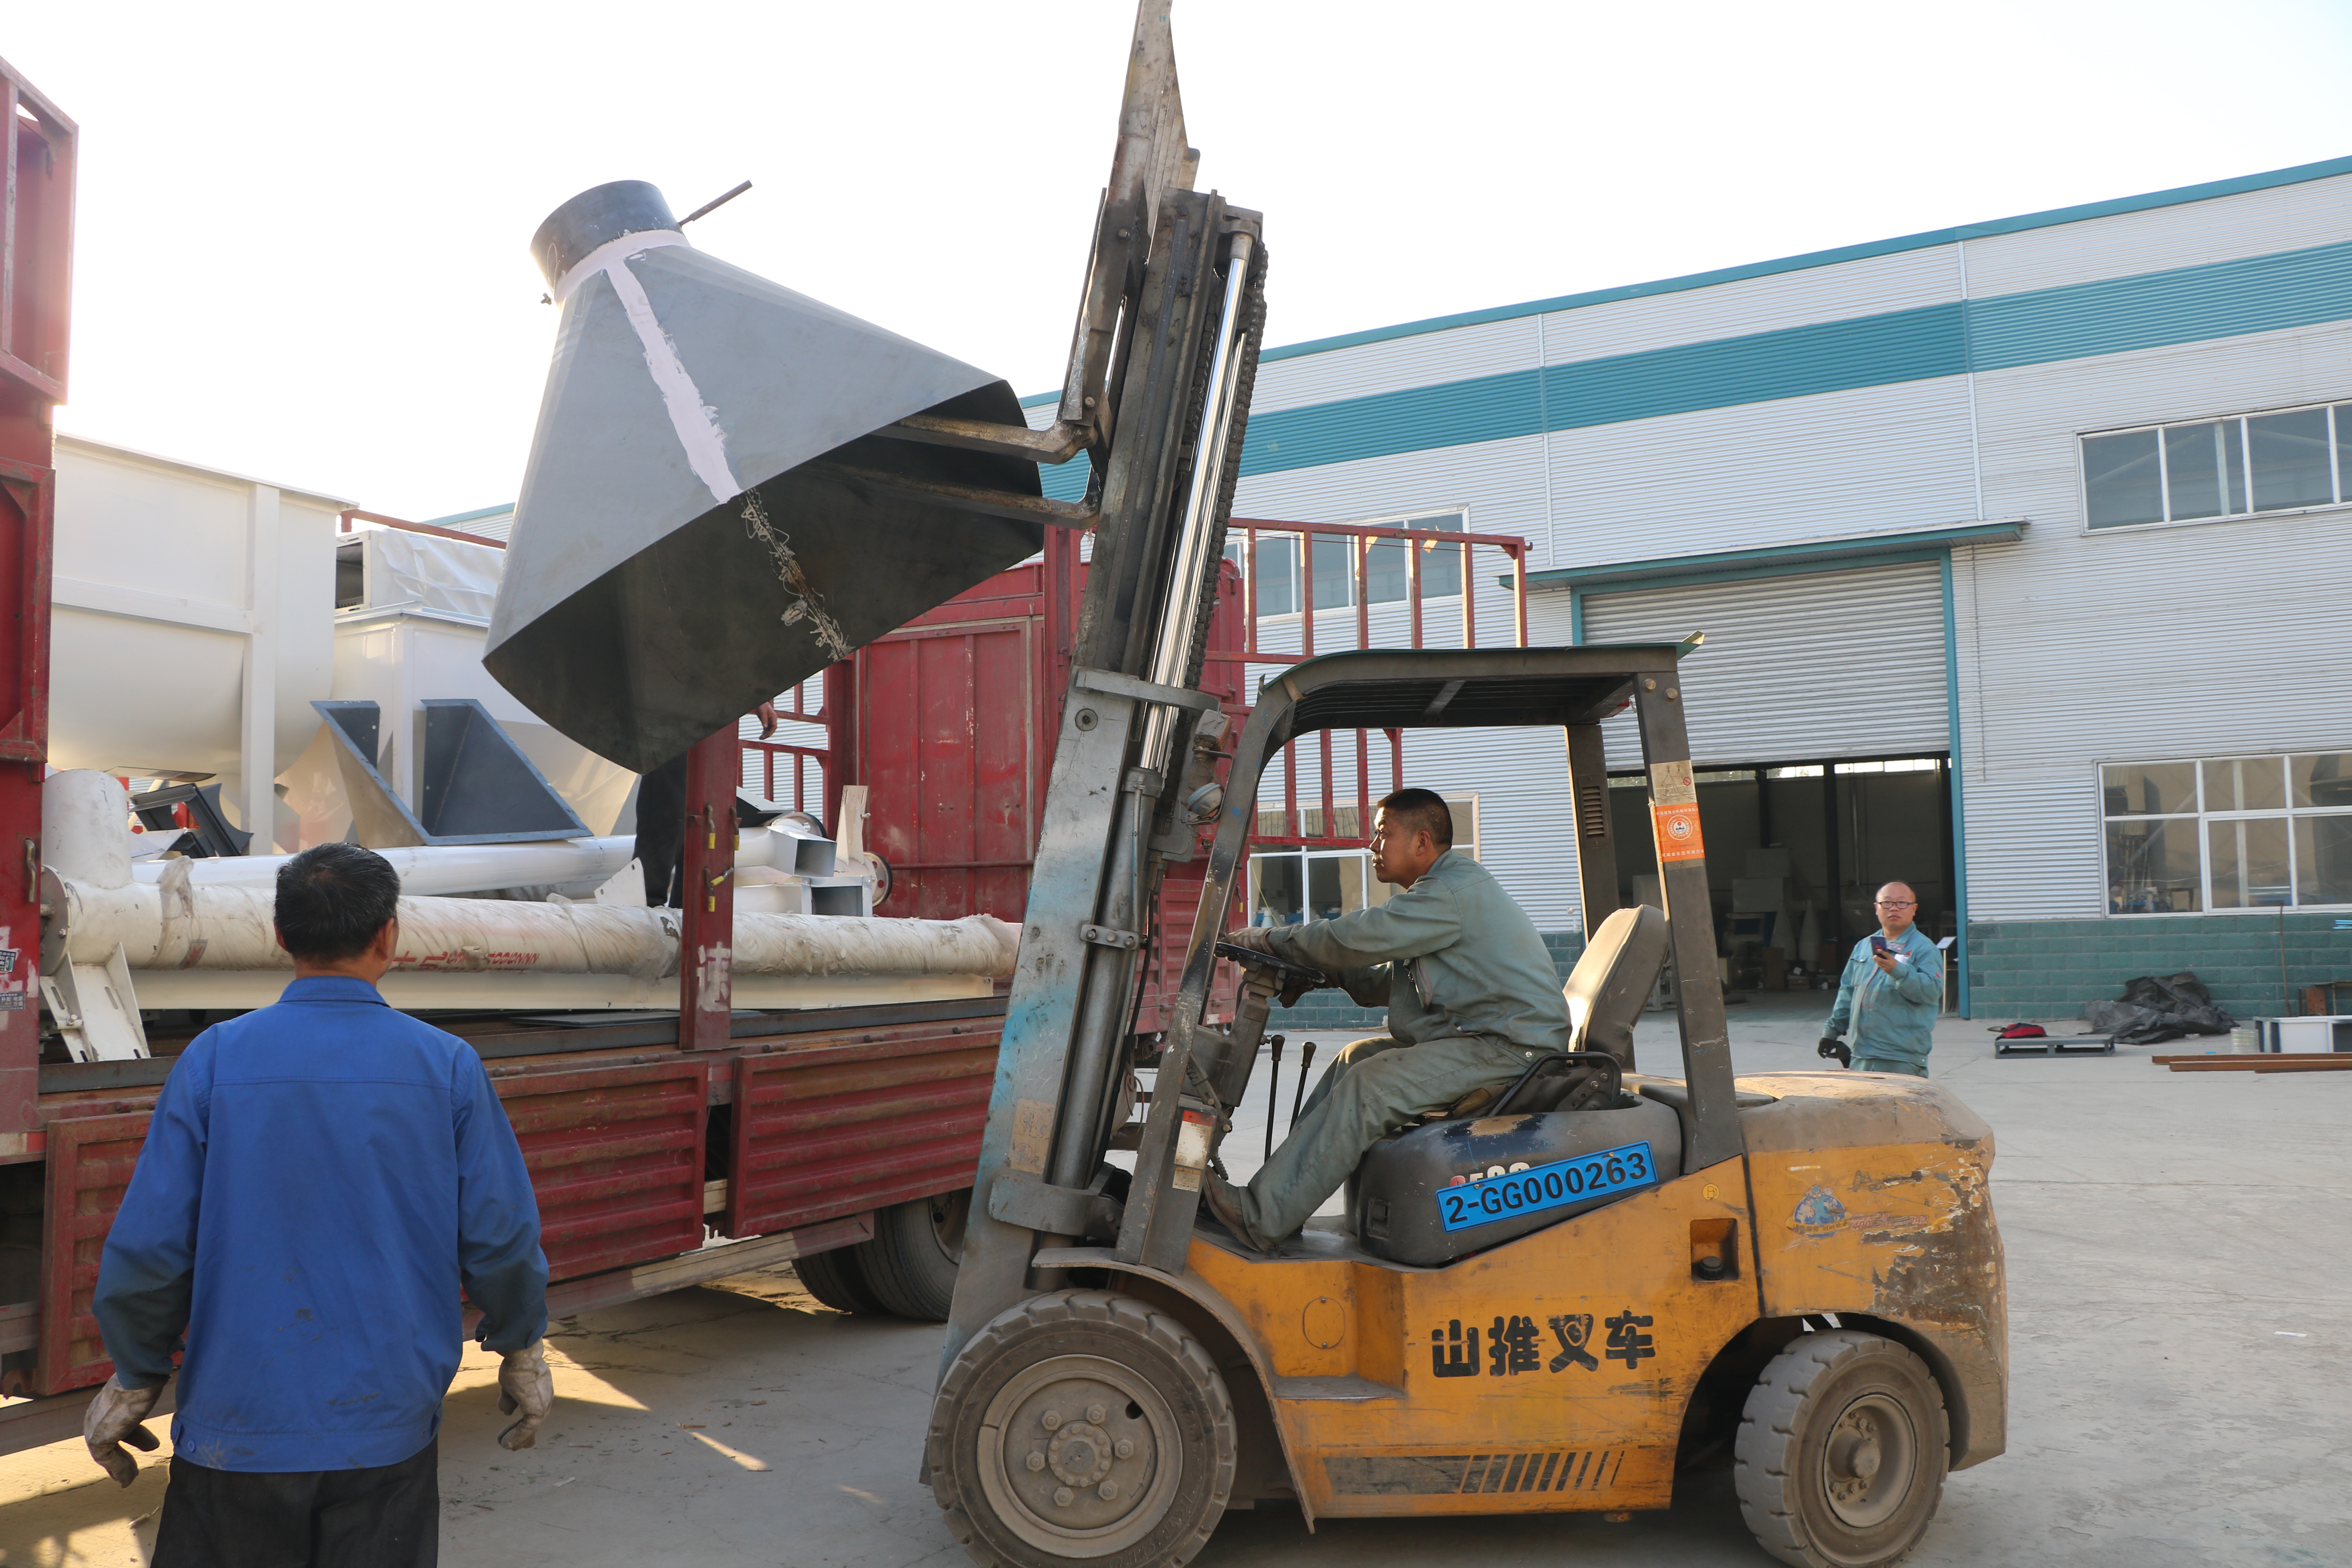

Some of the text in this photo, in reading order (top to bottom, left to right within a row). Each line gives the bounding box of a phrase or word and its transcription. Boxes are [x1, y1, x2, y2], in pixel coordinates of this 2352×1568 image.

[1446, 1152, 1647, 1223] 2-GG000263
[1432, 1310, 1655, 1377] 山推叉车
